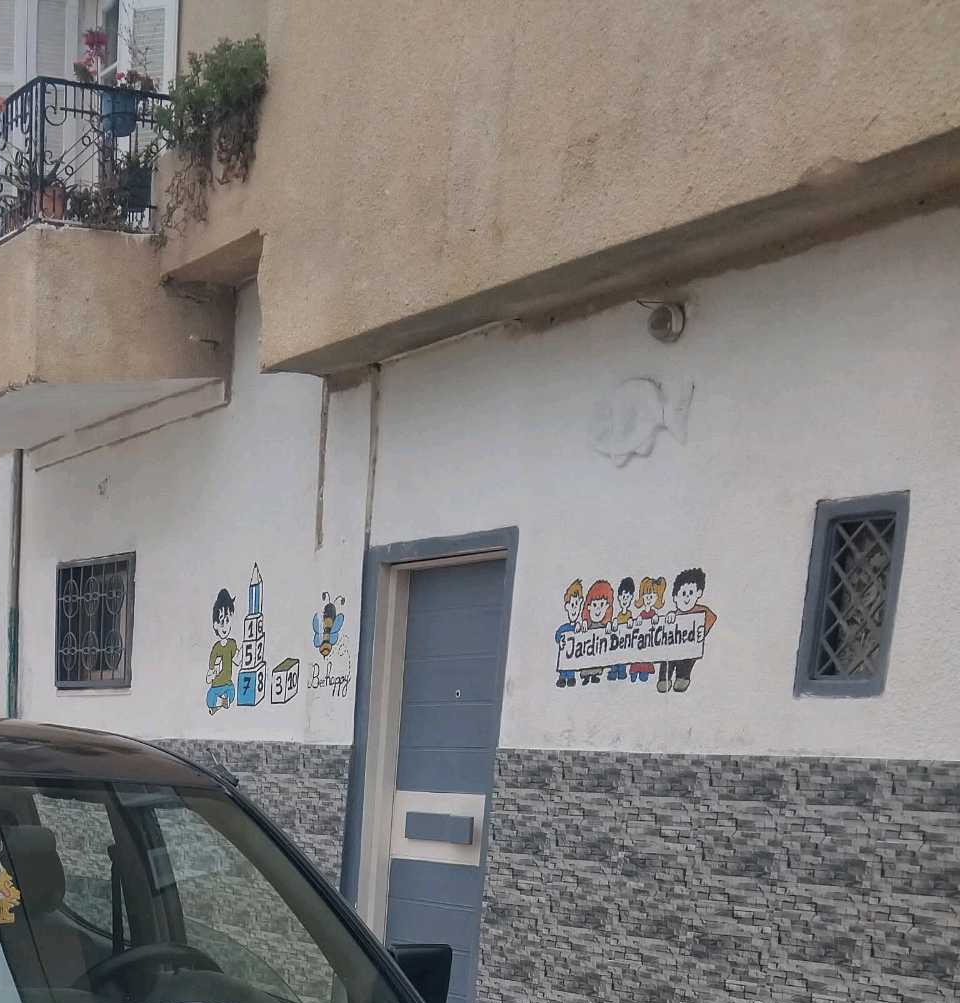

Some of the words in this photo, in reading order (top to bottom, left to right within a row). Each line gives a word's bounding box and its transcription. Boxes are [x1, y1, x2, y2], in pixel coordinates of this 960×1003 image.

[247, 620, 254, 638] 1
[245, 643, 253, 666] 5
[257, 642, 263, 661] 2
[566, 632, 607, 659] Jardin
[243, 676, 251, 696] 7
[257, 671, 264, 692] 8
[275, 675, 283, 696] 3
[287, 671, 297, 691] 10
